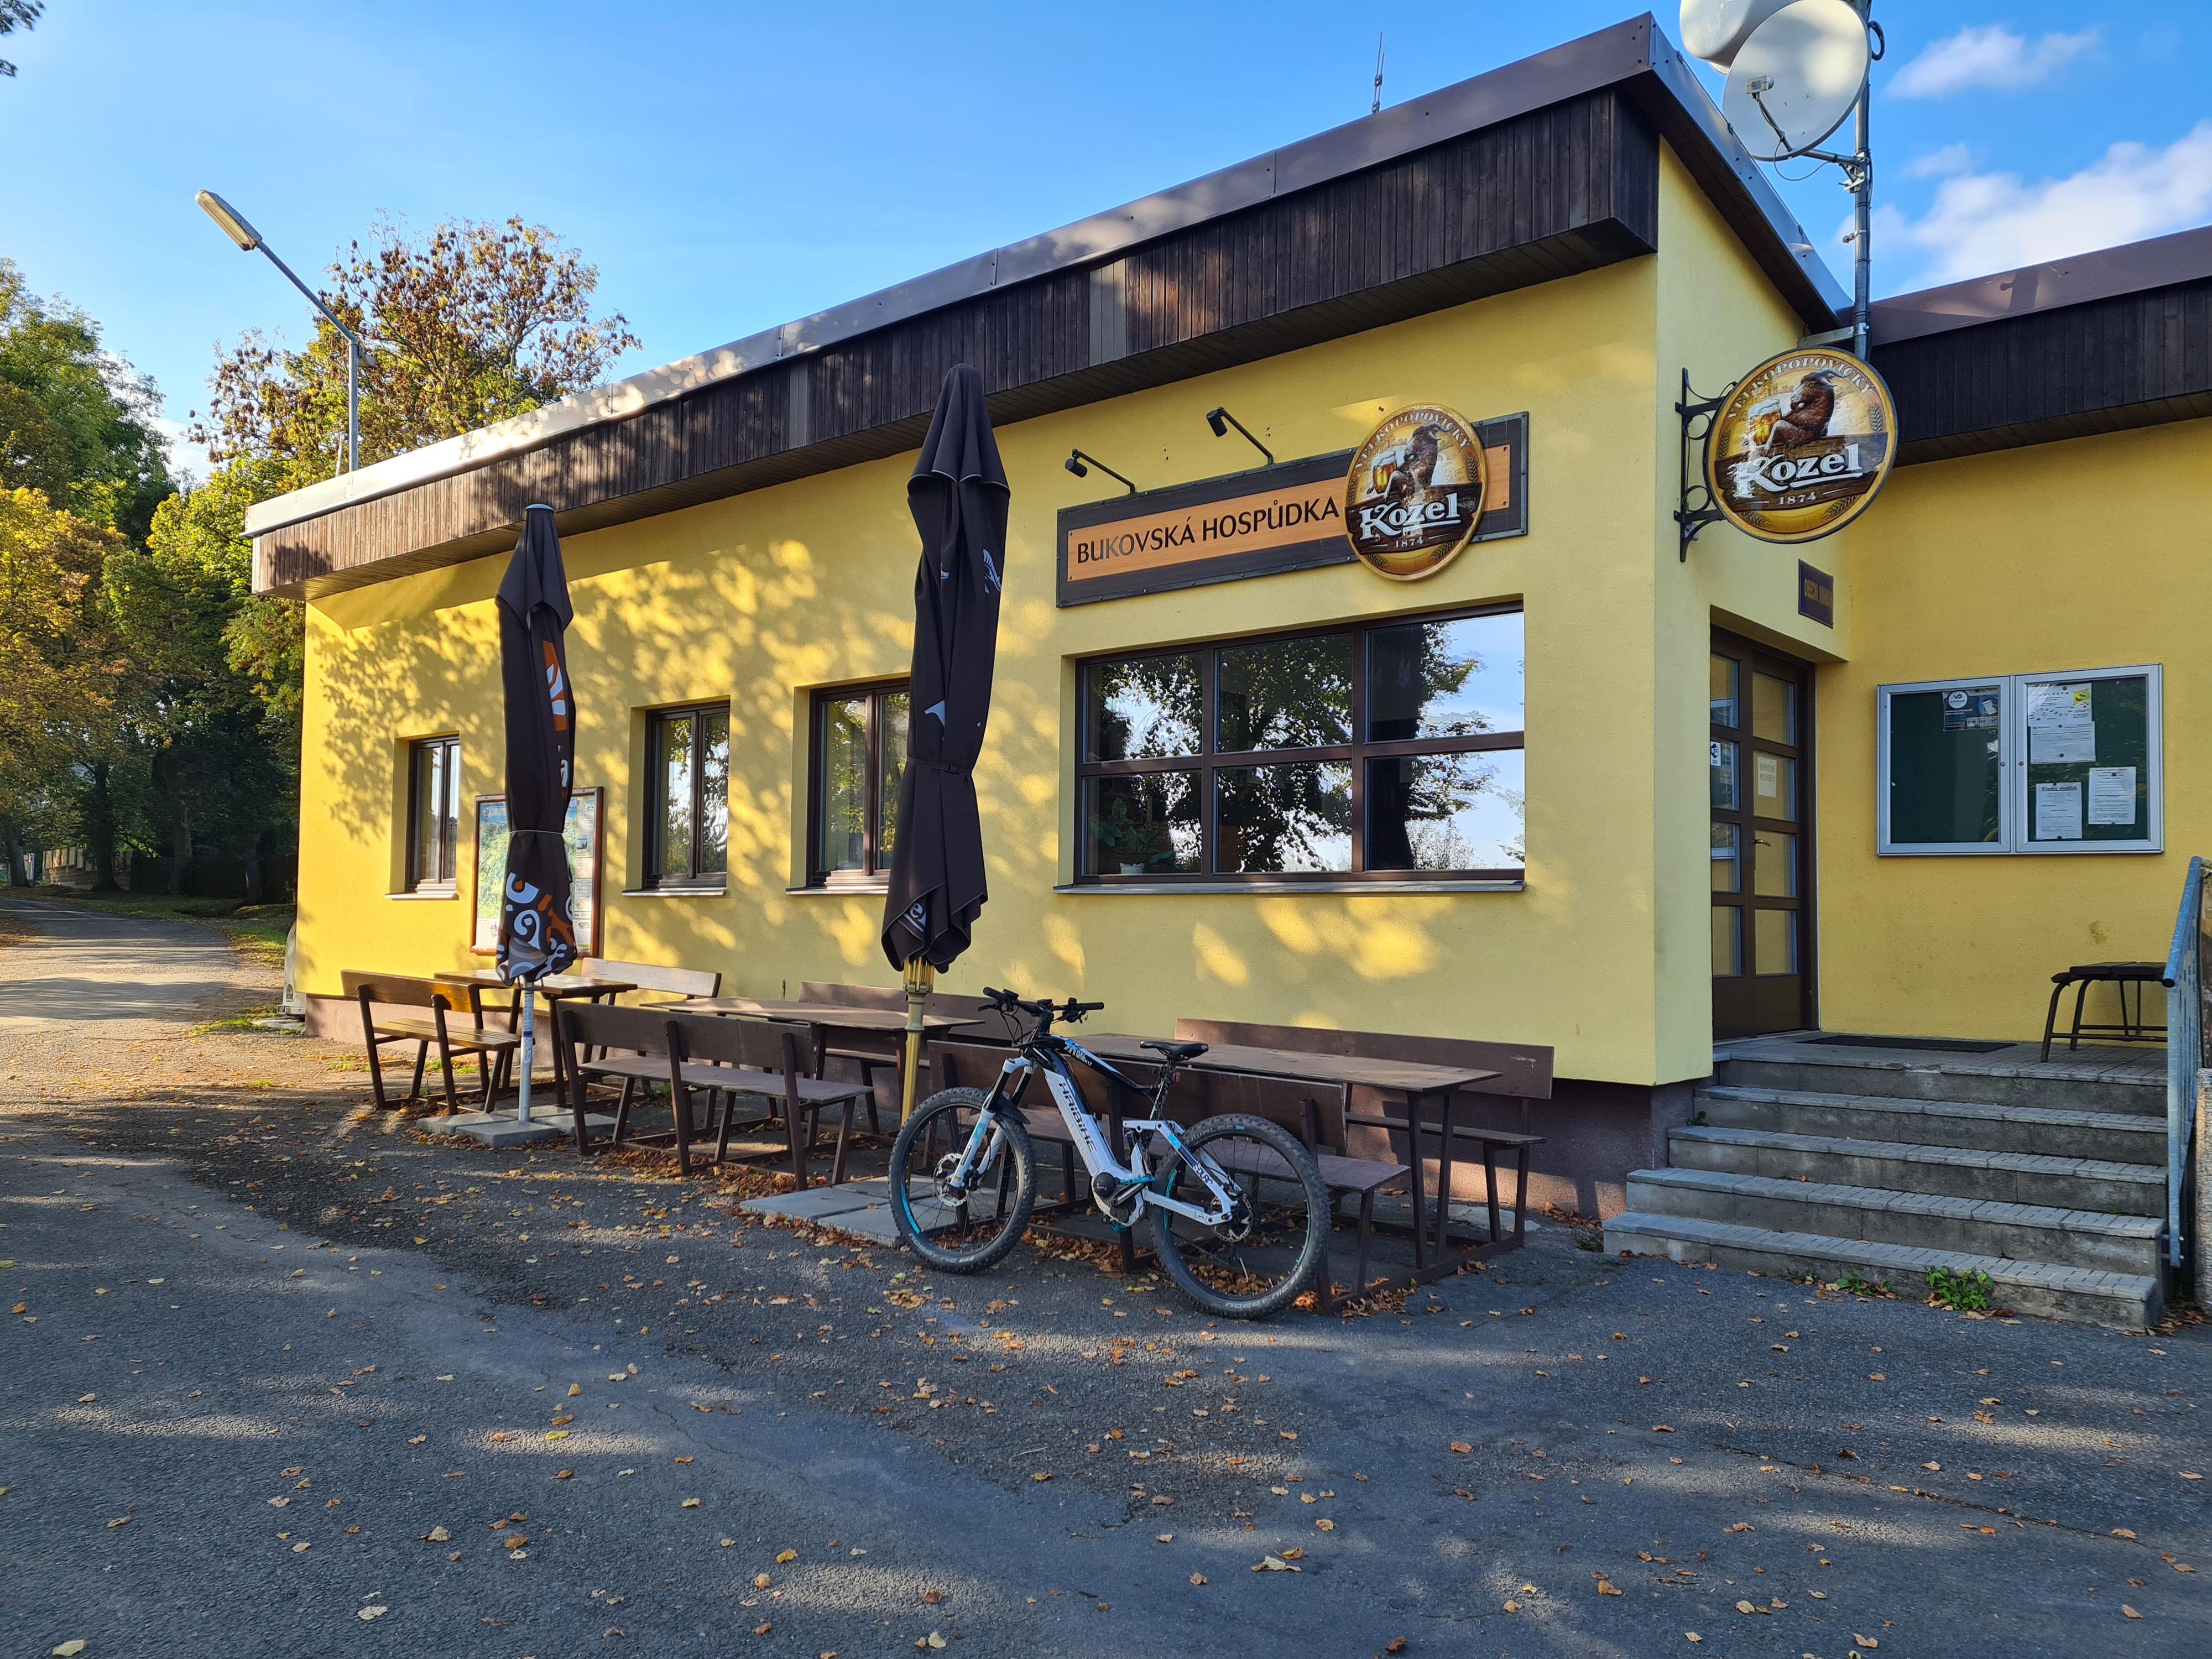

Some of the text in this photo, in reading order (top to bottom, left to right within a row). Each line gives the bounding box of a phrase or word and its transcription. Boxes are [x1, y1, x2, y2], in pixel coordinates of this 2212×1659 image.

[1727, 357, 1875, 419] VELKOPOPOVICKÝ
[1728, 444, 1863, 498] Kozel
[1358, 492, 1461, 541] Kozel
[1778, 492, 1817, 505] 1874
[1077, 495, 1340, 564] BUKOVSKÁ HOSPŮDKA
[1394, 538, 1425, 548] 1874
